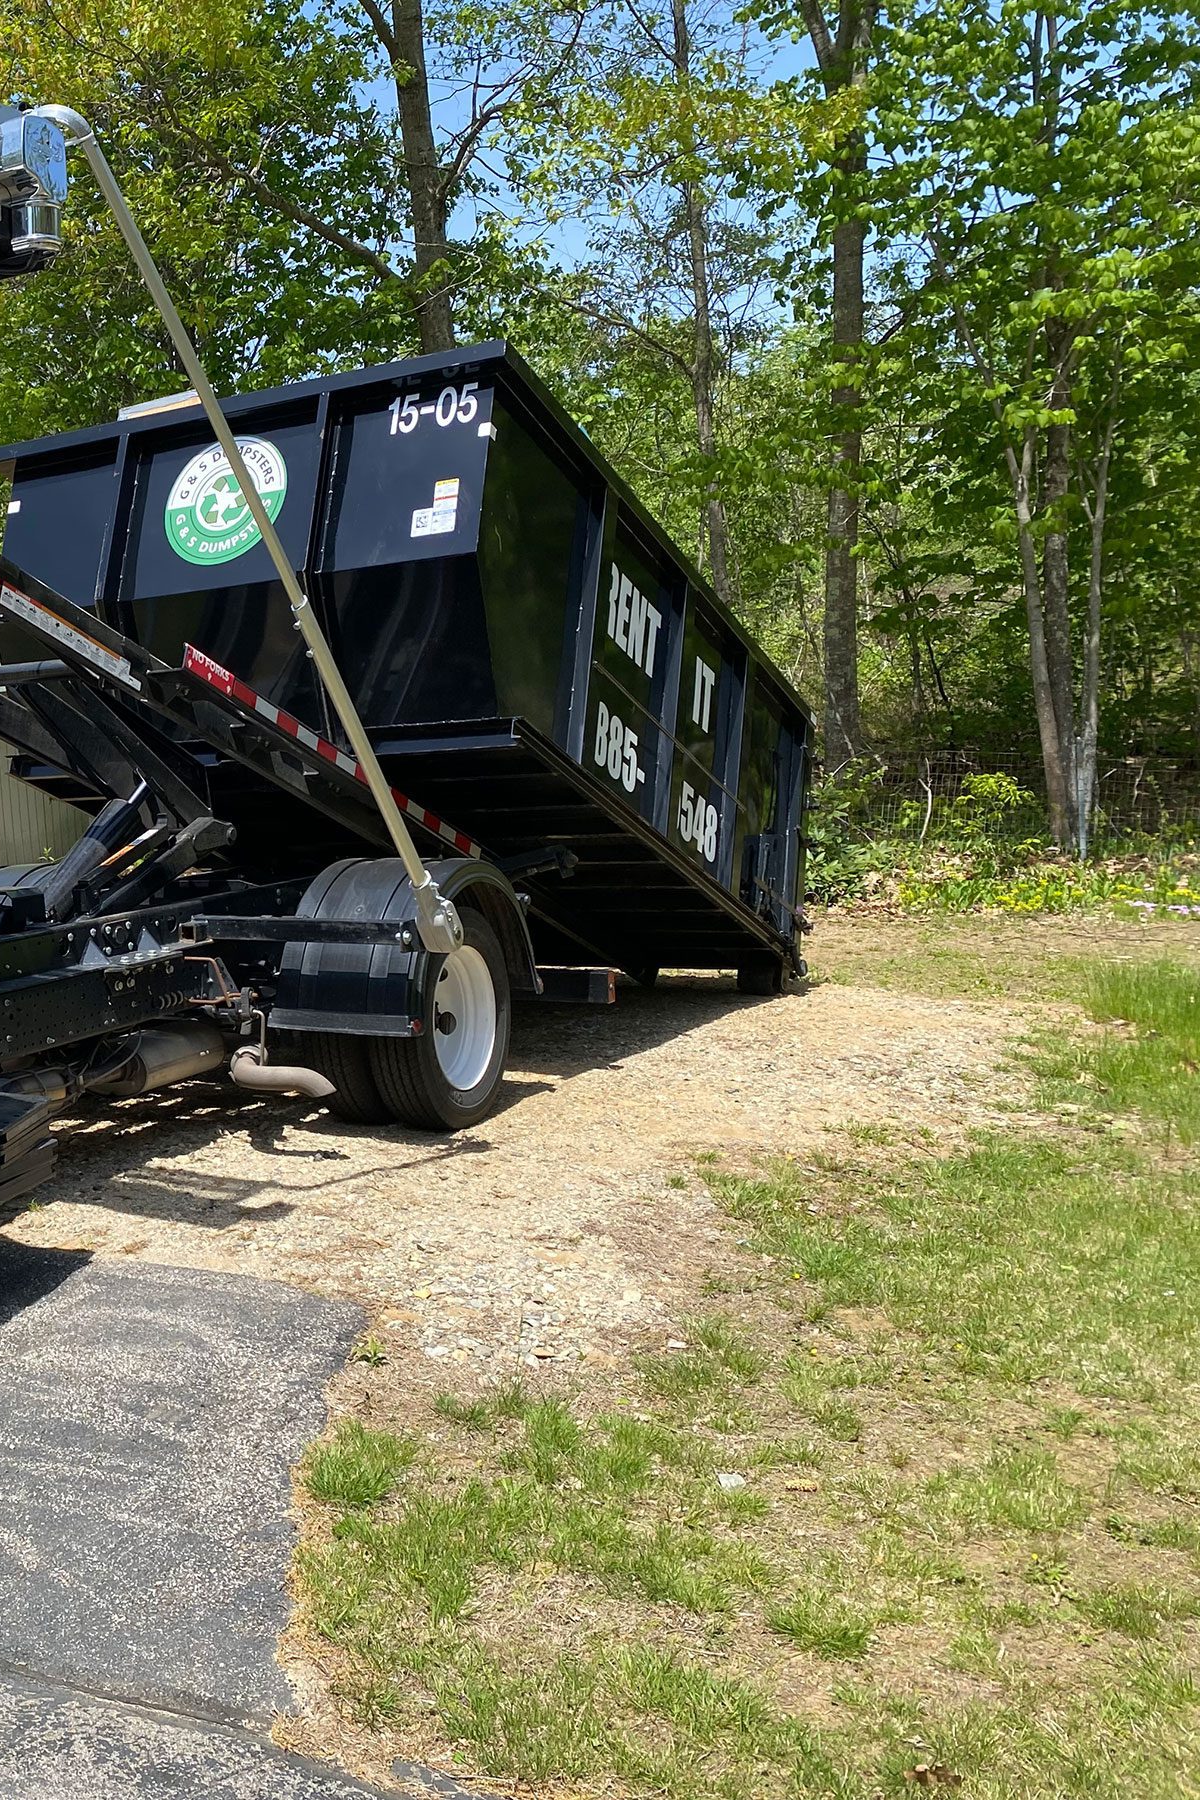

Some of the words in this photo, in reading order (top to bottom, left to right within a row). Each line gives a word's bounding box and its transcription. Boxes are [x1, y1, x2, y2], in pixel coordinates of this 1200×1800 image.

[388, 382, 479, 435] 15-05
[180, 491, 189, 500] G
[187, 475, 198, 486] &
[199, 462, 208, 472] S
[176, 513, 186, 525] G
[179, 527, 190, 539] &
[187, 537, 198, 548] S
[192, 649, 205, 664] NO
[205, 659, 230, 682] FORKS
[692, 655, 716, 734] IT
[676, 780, 718, 863] 548
